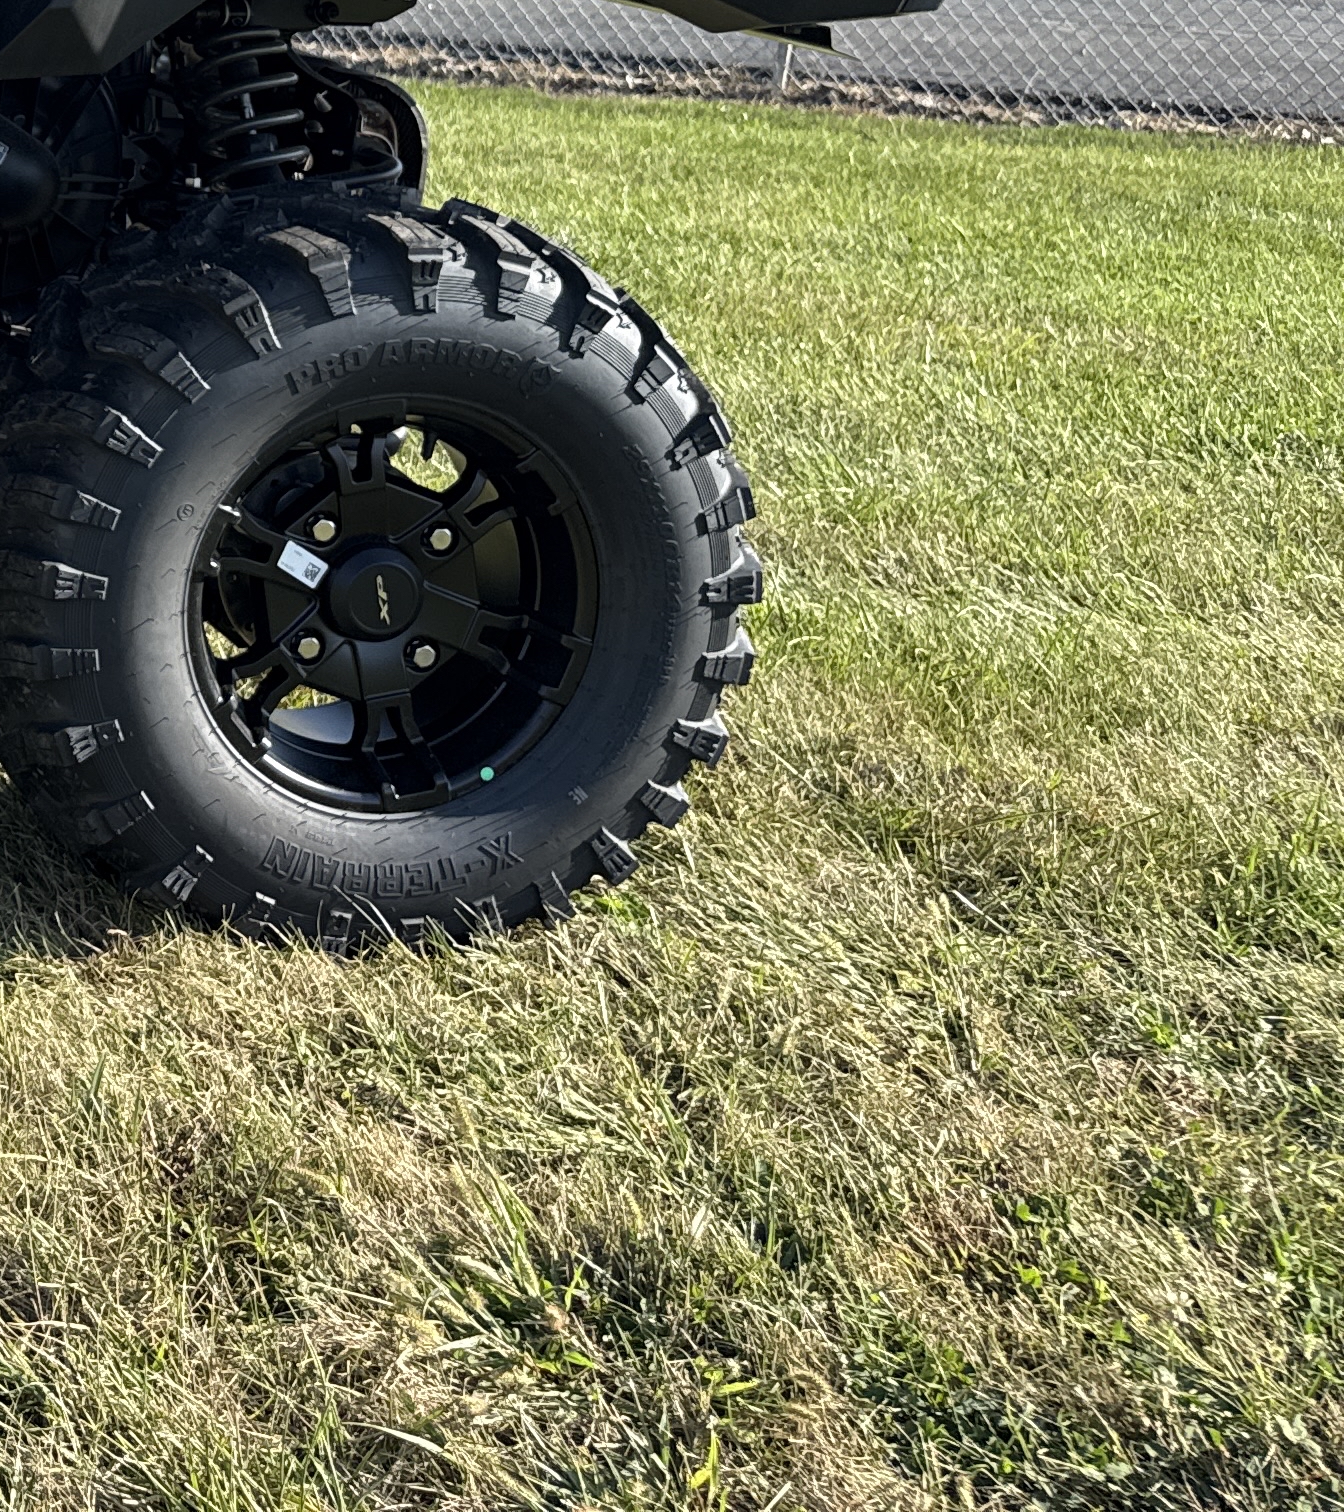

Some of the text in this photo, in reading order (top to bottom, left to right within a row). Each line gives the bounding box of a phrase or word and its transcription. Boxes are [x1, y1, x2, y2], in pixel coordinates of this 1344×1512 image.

[282, 337, 523, 396] PRO ARMOR
[375, 574, 391, 626] XP
[261, 831, 525, 898] X-TERRAIN
